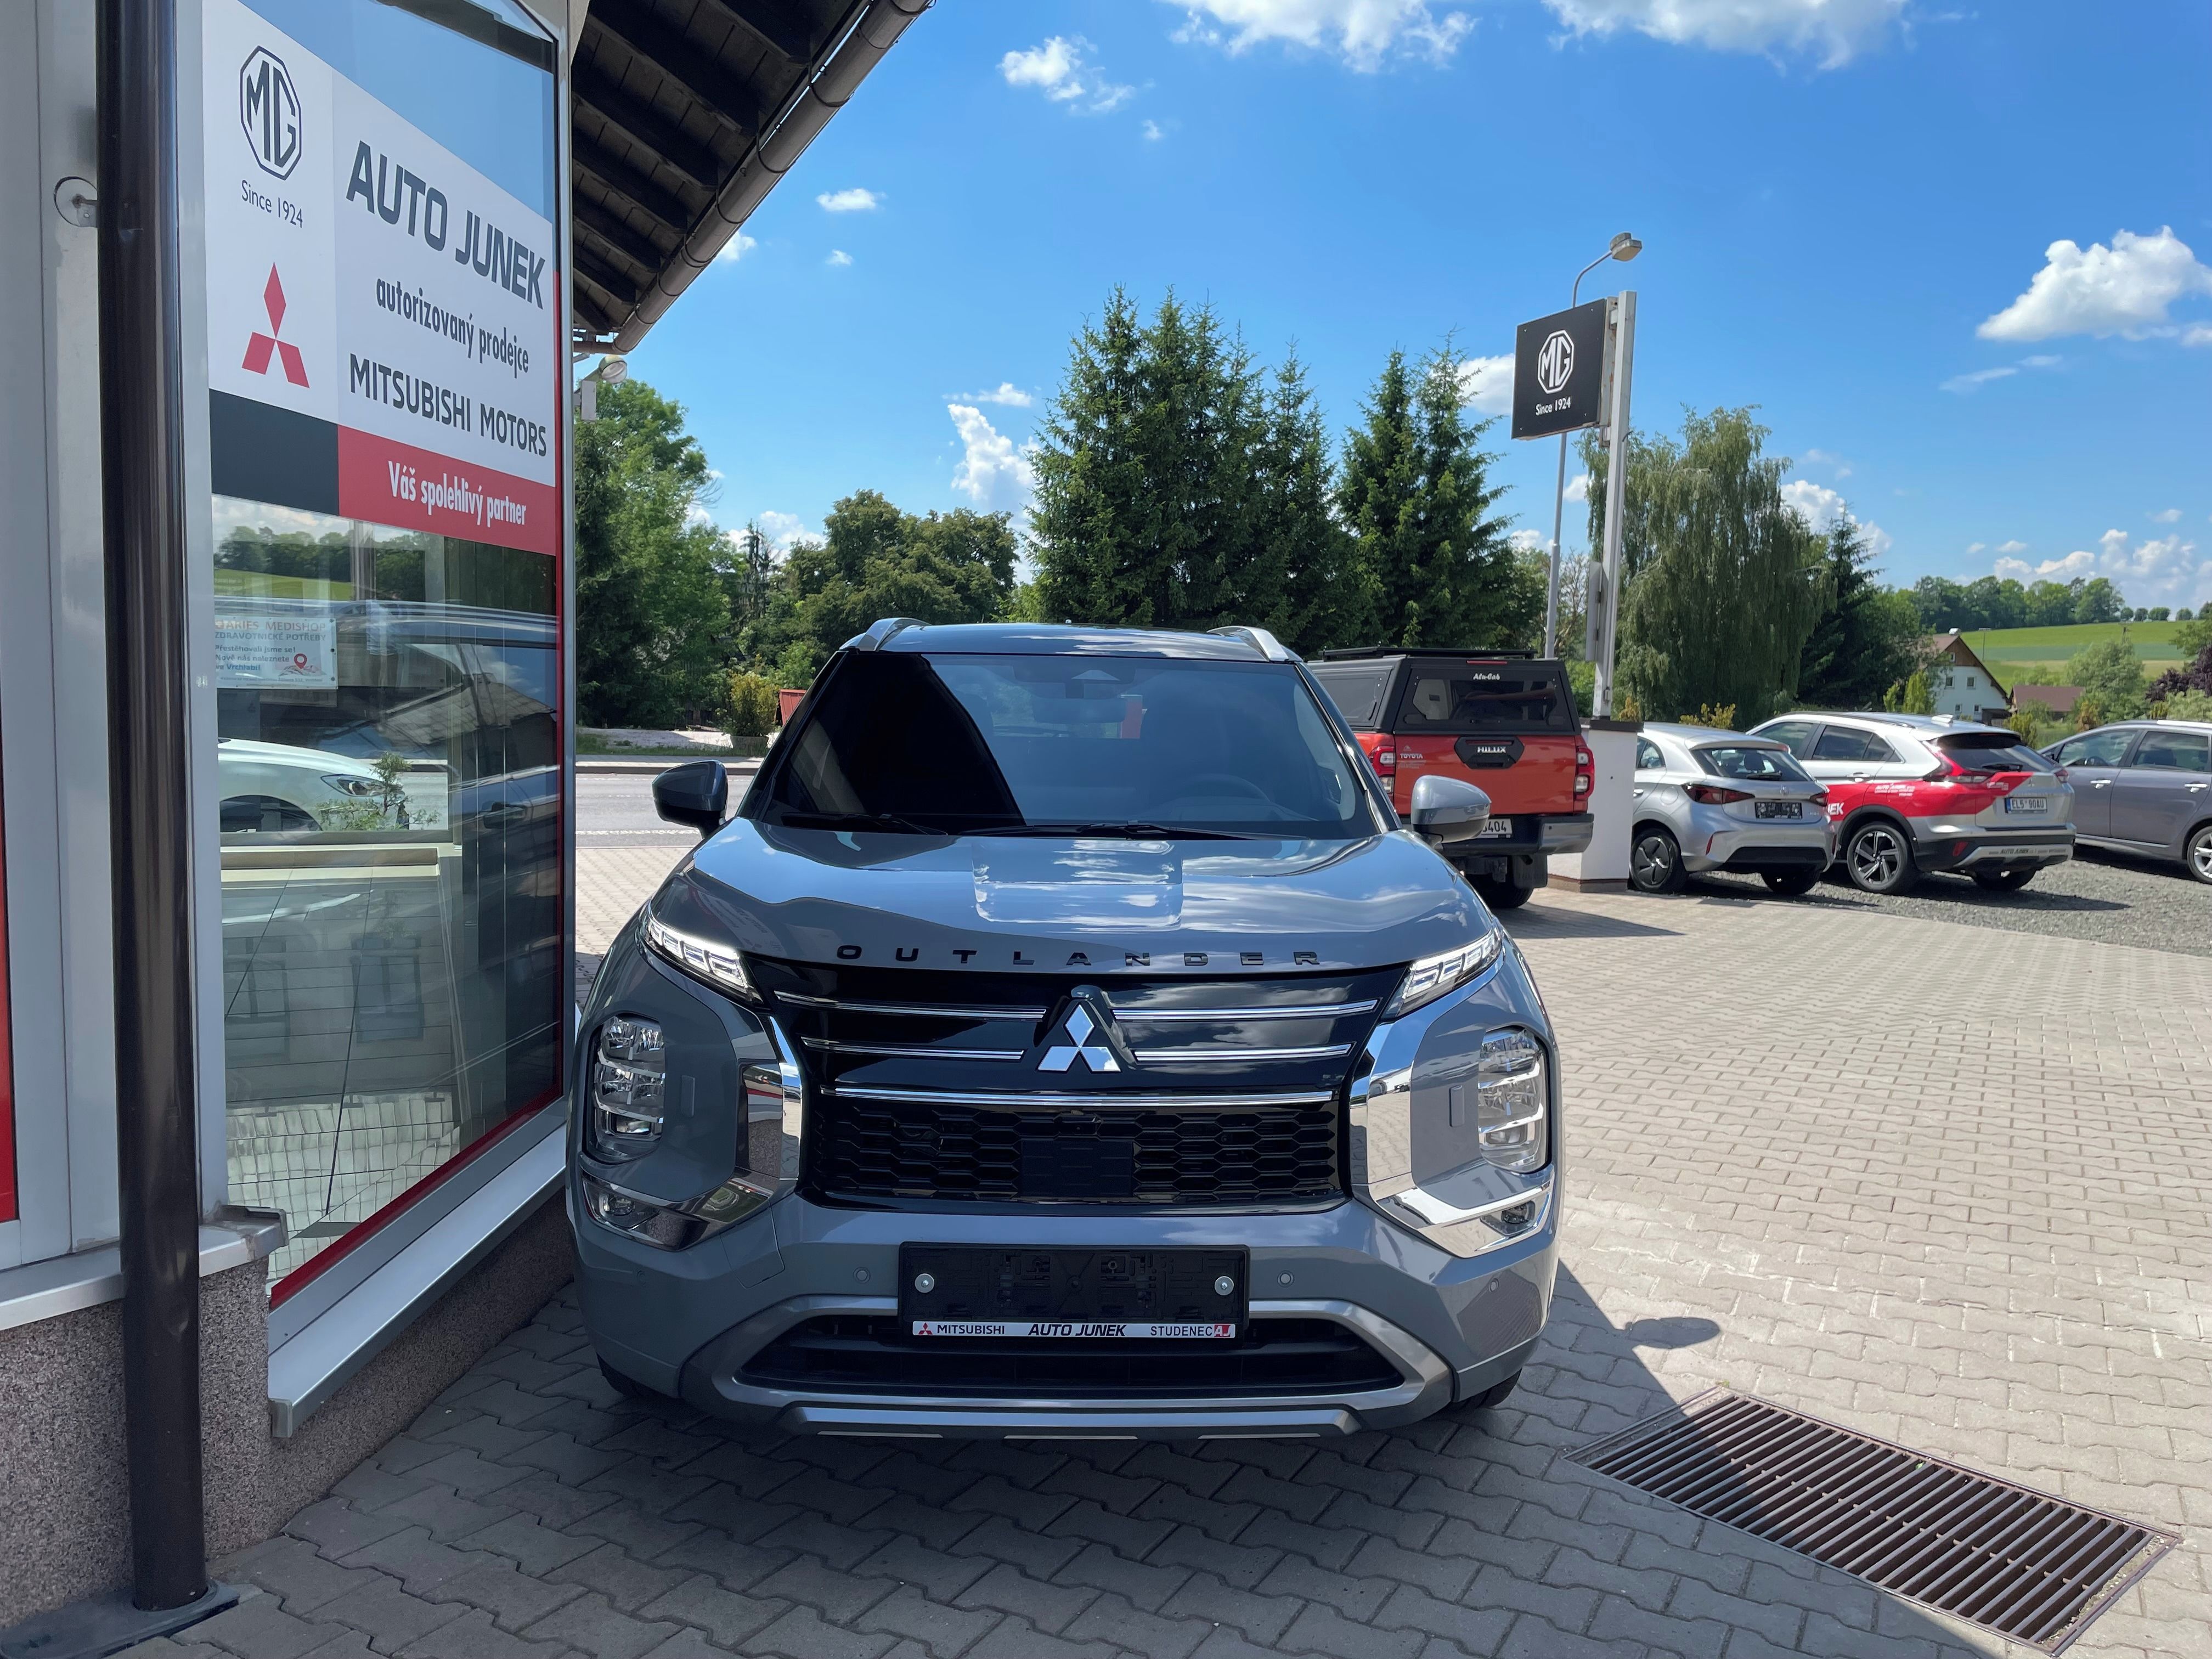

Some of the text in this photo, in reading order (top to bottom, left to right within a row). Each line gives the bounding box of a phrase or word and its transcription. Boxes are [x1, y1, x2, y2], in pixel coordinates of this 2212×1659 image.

[246, 60, 296, 168] MG
[241, 179, 303, 228] Since 1924
[346, 140, 545, 310] AUTO JUNEK
[376, 278, 529, 379] autorizovaný prodejce
[1541, 336, 1571, 388] MG
[349, 353, 546, 456] MITSUBISHI MOTORS
[1536, 396, 1571, 416] Since 1924
[388, 460, 527, 528] Váš spolehlivý partner
[215, 631, 326, 641] ZDRAVOTNICKÉ POTŘEBY
[226, 620, 326, 631] ARIES MEDISHOP
[837, 945, 1320, 966] OUTLANDER
[937, 1324, 1005, 1335] MITSUBISHI
[1028, 1324, 1073, 1336] AUTO
[1075, 1324, 1127, 1336] JUNEK
[1150, 1325, 1213, 1336] STUDENEC
